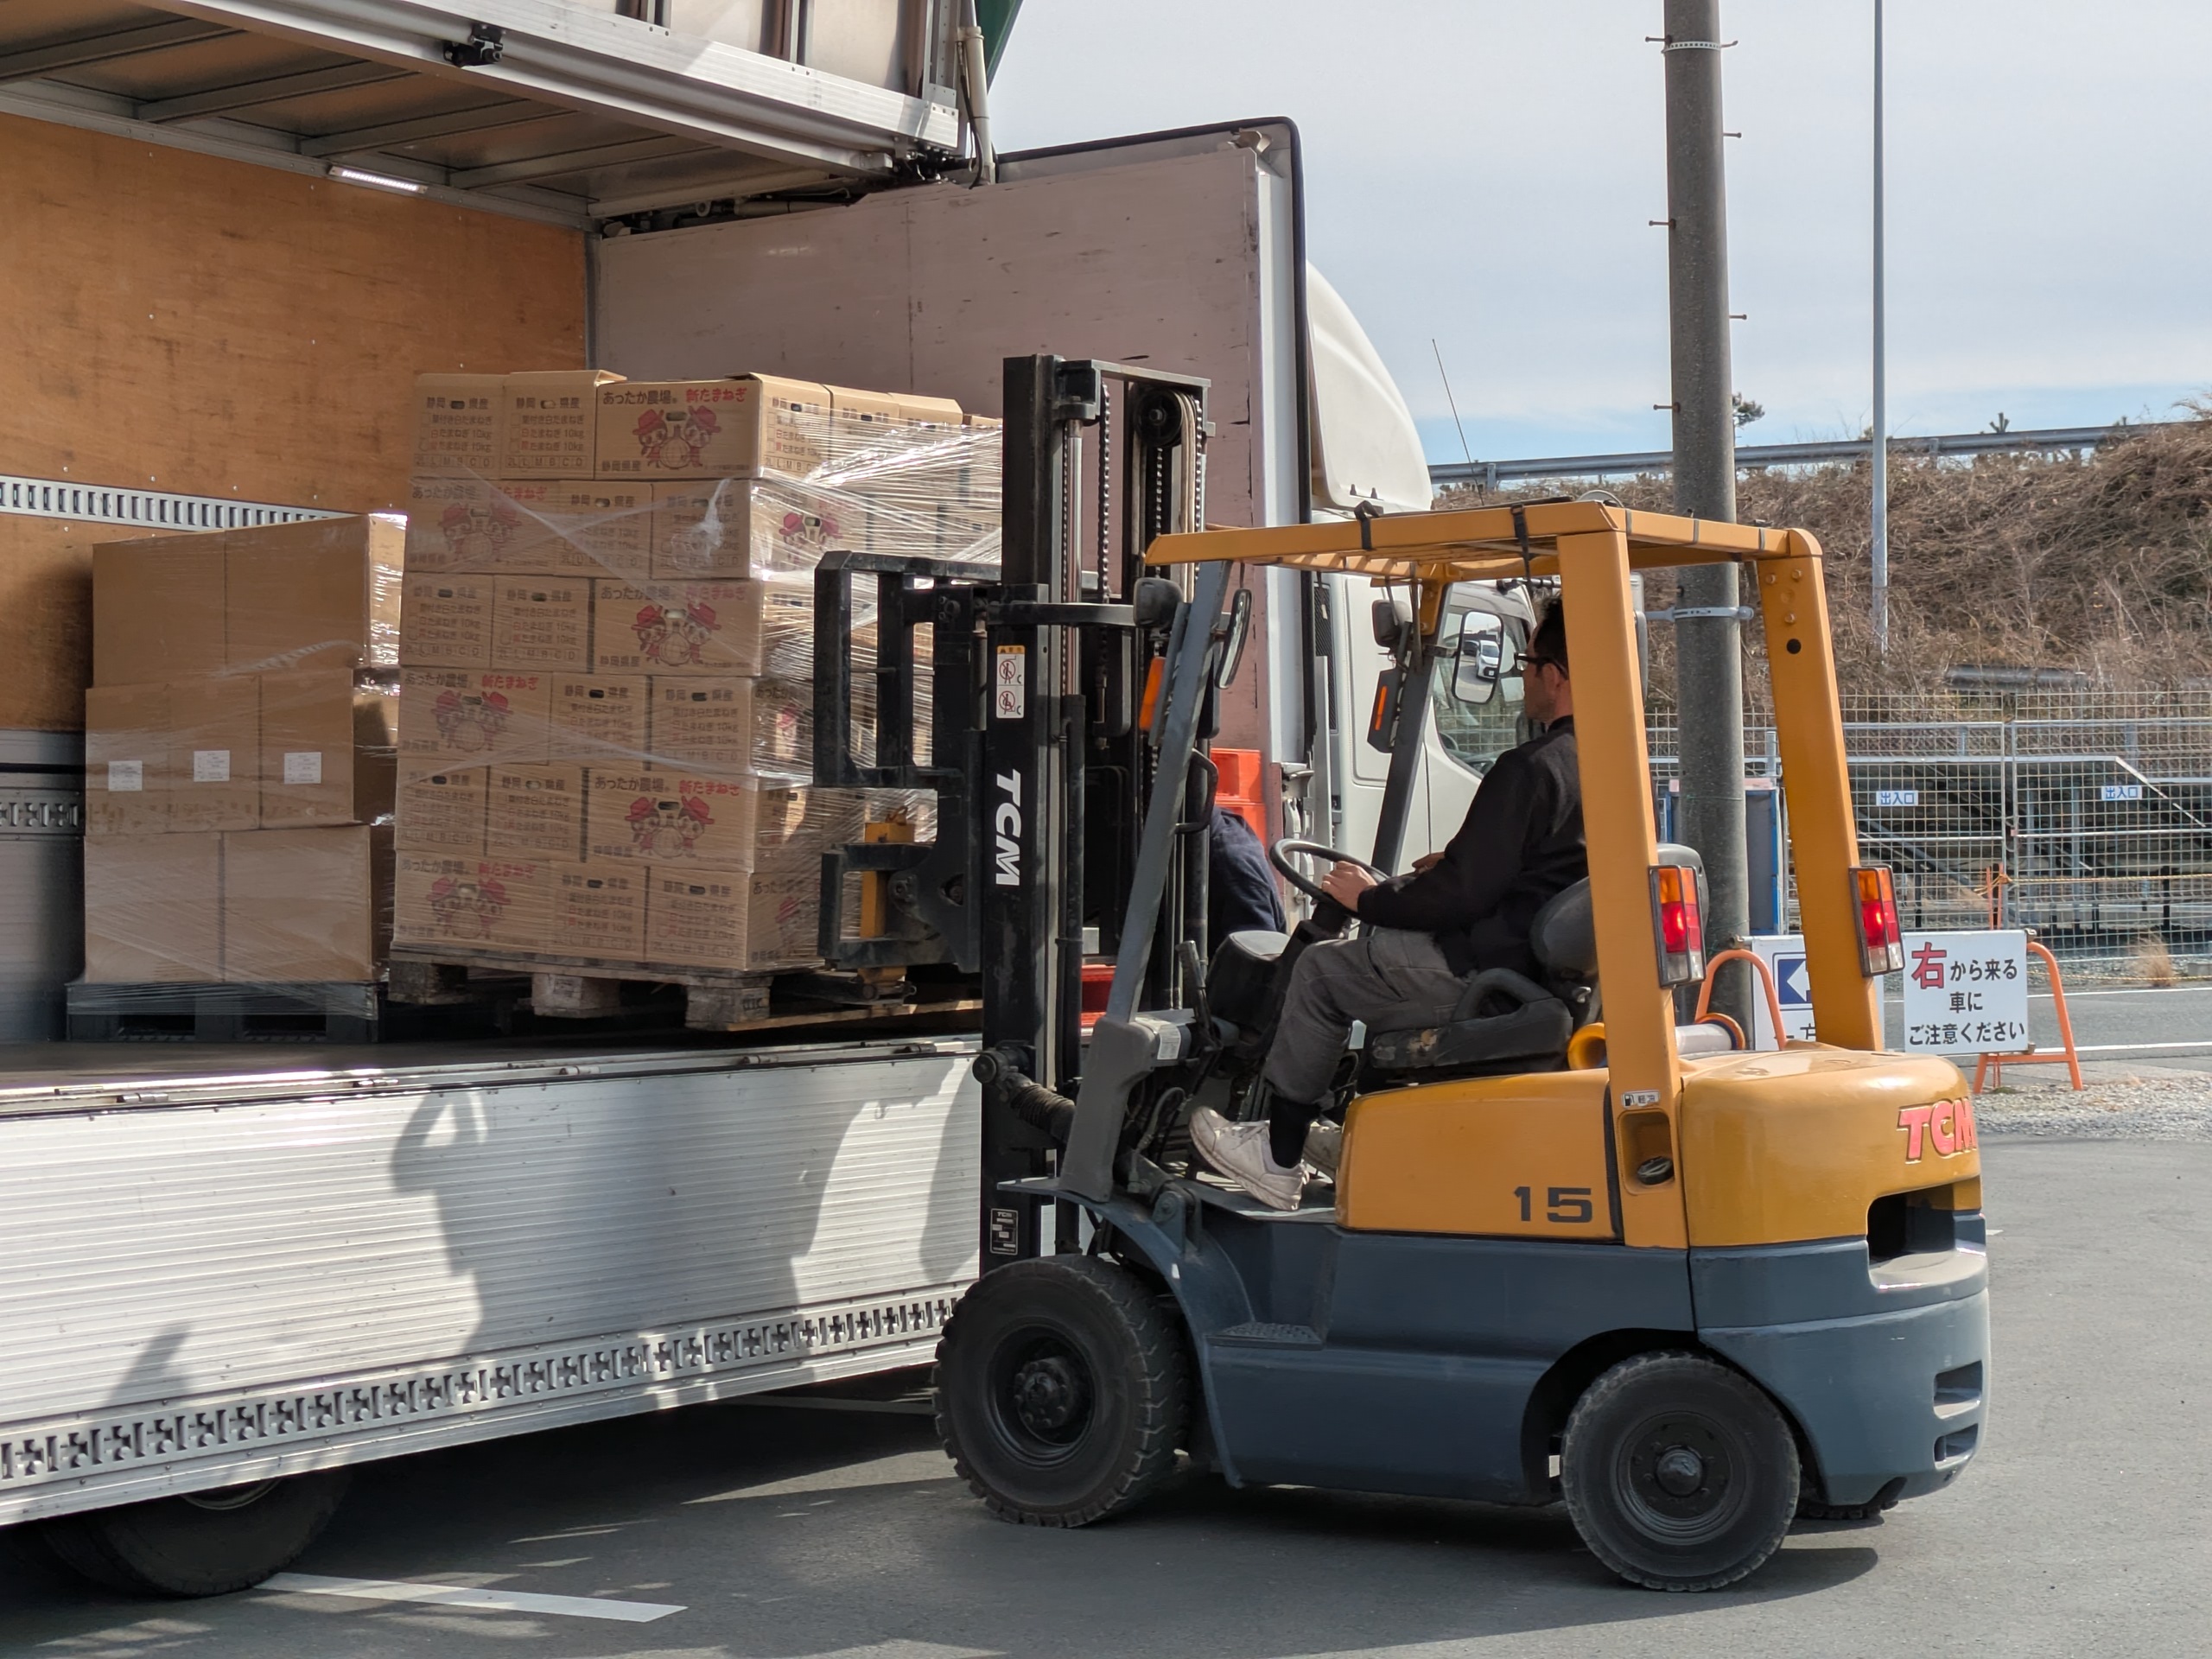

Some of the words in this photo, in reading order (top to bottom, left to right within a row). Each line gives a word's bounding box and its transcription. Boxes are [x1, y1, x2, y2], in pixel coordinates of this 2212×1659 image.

[685, 387, 747, 403] 新たまねぎ
[1879, 791, 1916, 805] 出入口
[2106, 786, 2139, 800] 出入口
[995, 769, 1021, 886] TCM
[1910, 941, 2018, 990] 右から来る
[1949, 992, 1983, 1014] 車に
[1910, 1021, 2024, 1046] ご注意ください
[1897, 1096, 1978, 1164] TCM
[1514, 1186, 1593, 1224] 15
